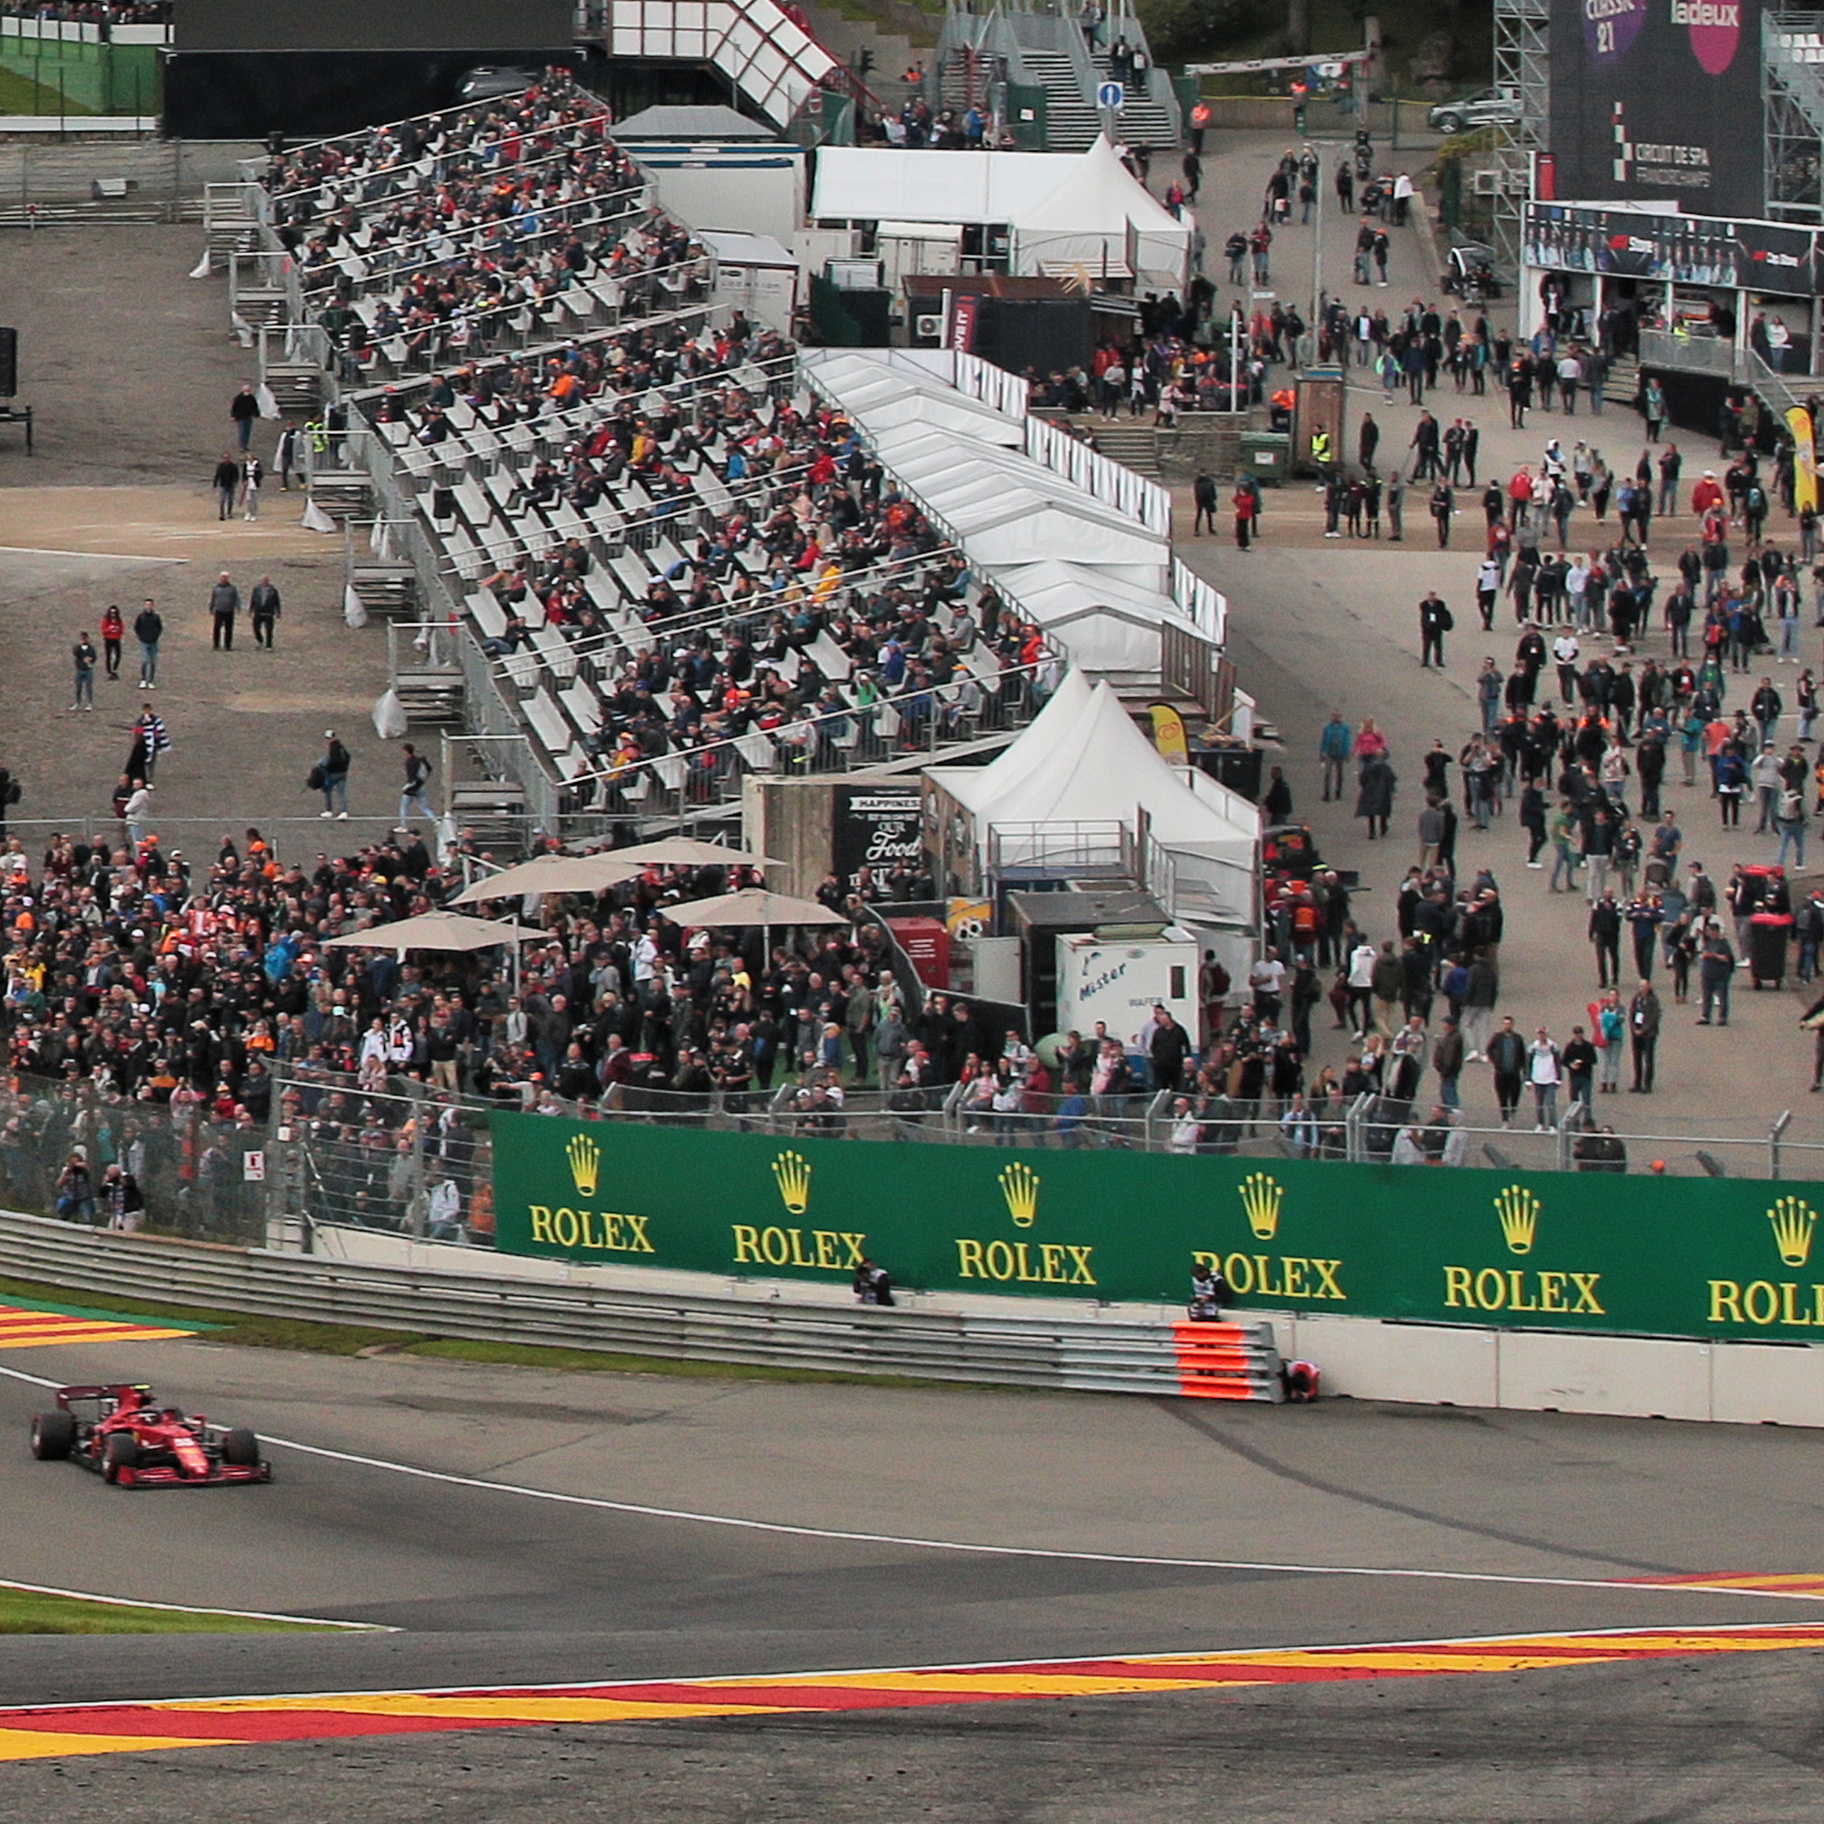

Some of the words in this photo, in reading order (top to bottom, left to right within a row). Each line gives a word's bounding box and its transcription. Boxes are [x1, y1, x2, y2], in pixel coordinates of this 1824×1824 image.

[1596, 21, 1615, 54] 21
[1635, 143, 1673, 164] CIRCUIT
[1674, 146, 1688, 164] DE
[1689, 147, 1711, 166] SPA
[865, 831, 923, 861] Food
[1079, 963, 1127, 1001] Mister
[528, 1205, 655, 1254] ROLEX
[731, 1224, 868, 1271] ROLEX
[955, 1239, 1097, 1286] ROLEX
[1443, 1266, 1606, 1315] ROLEX
[1707, 1280, 1824, 1326] ROL
